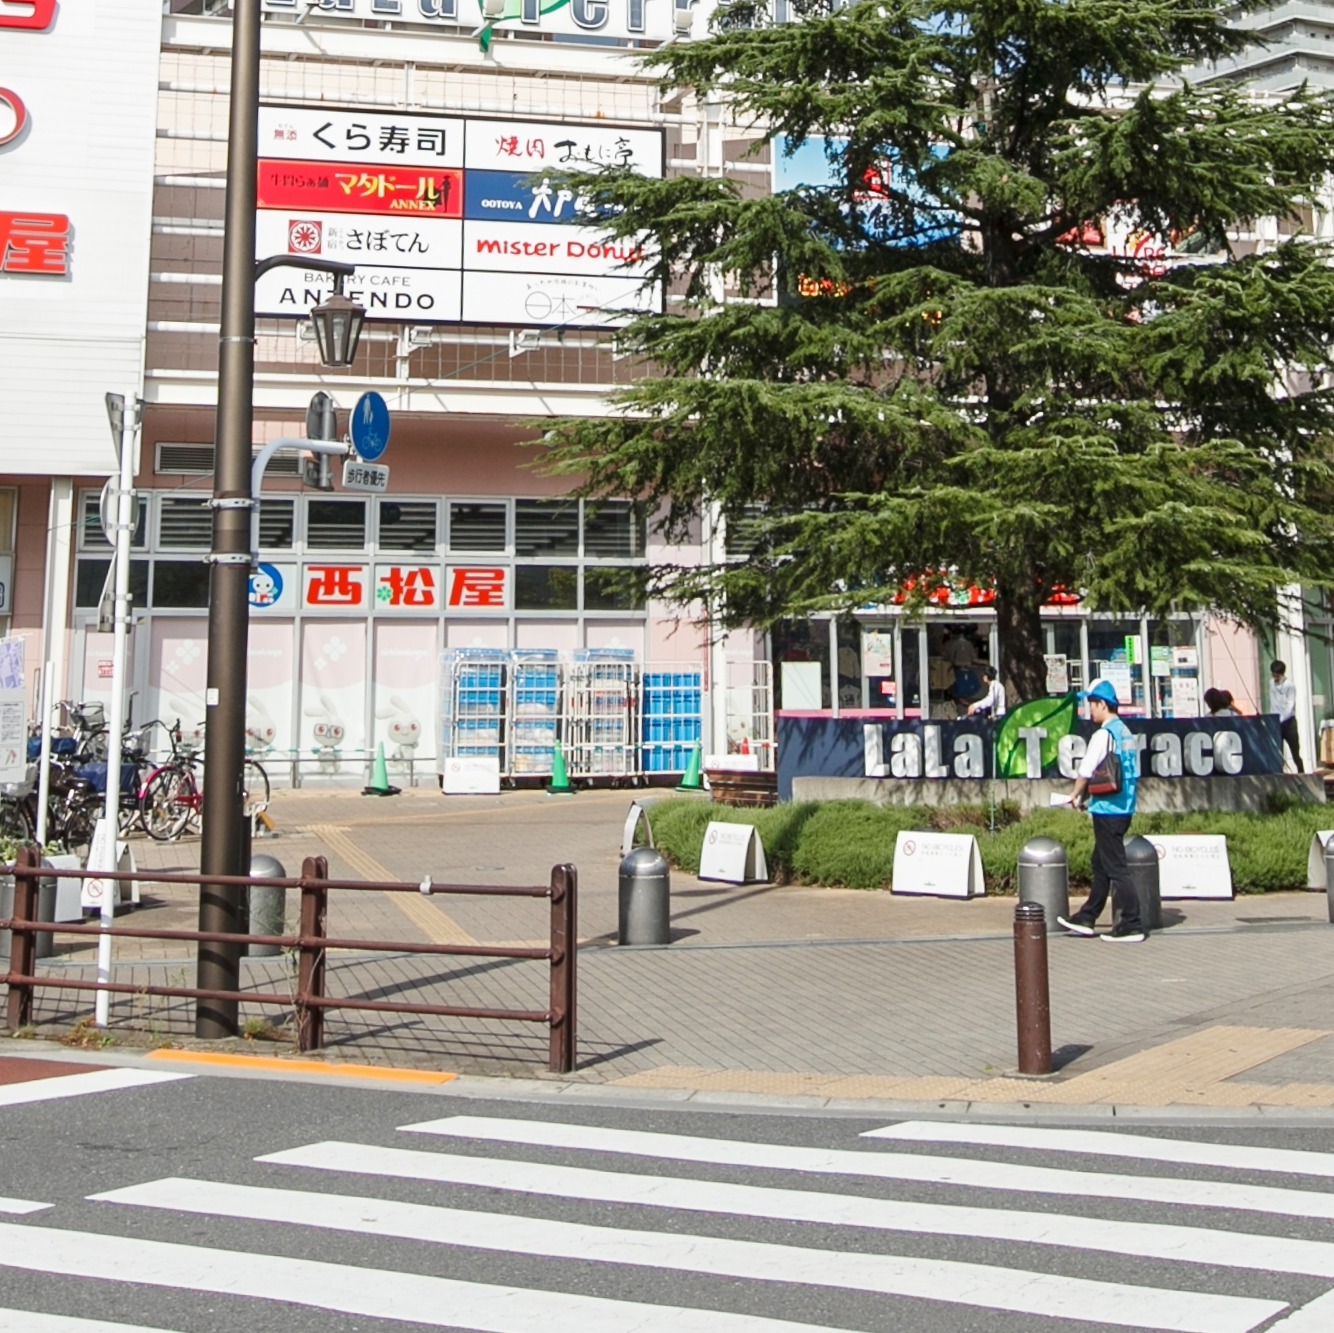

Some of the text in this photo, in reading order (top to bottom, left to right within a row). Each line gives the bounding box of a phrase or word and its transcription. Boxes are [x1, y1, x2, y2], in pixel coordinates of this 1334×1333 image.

[312, 121, 447, 156] くら寿司
[495, 135, 546, 159] 焼肉
[334, 172, 440, 200] マタドール
[389, 198, 436, 211] ANNEX
[481, 198, 524, 210] OOTOYA
[346, 228, 430, 254] さぼてん
[304, 272, 412, 287] BAKRY CAFE
[279, 287, 435, 310] ANENDO
[347, 468, 386, 487] 歩行者優先
[306, 565, 505, 607] 西松屋
[863, 723, 1244, 780] LaLa Terace
